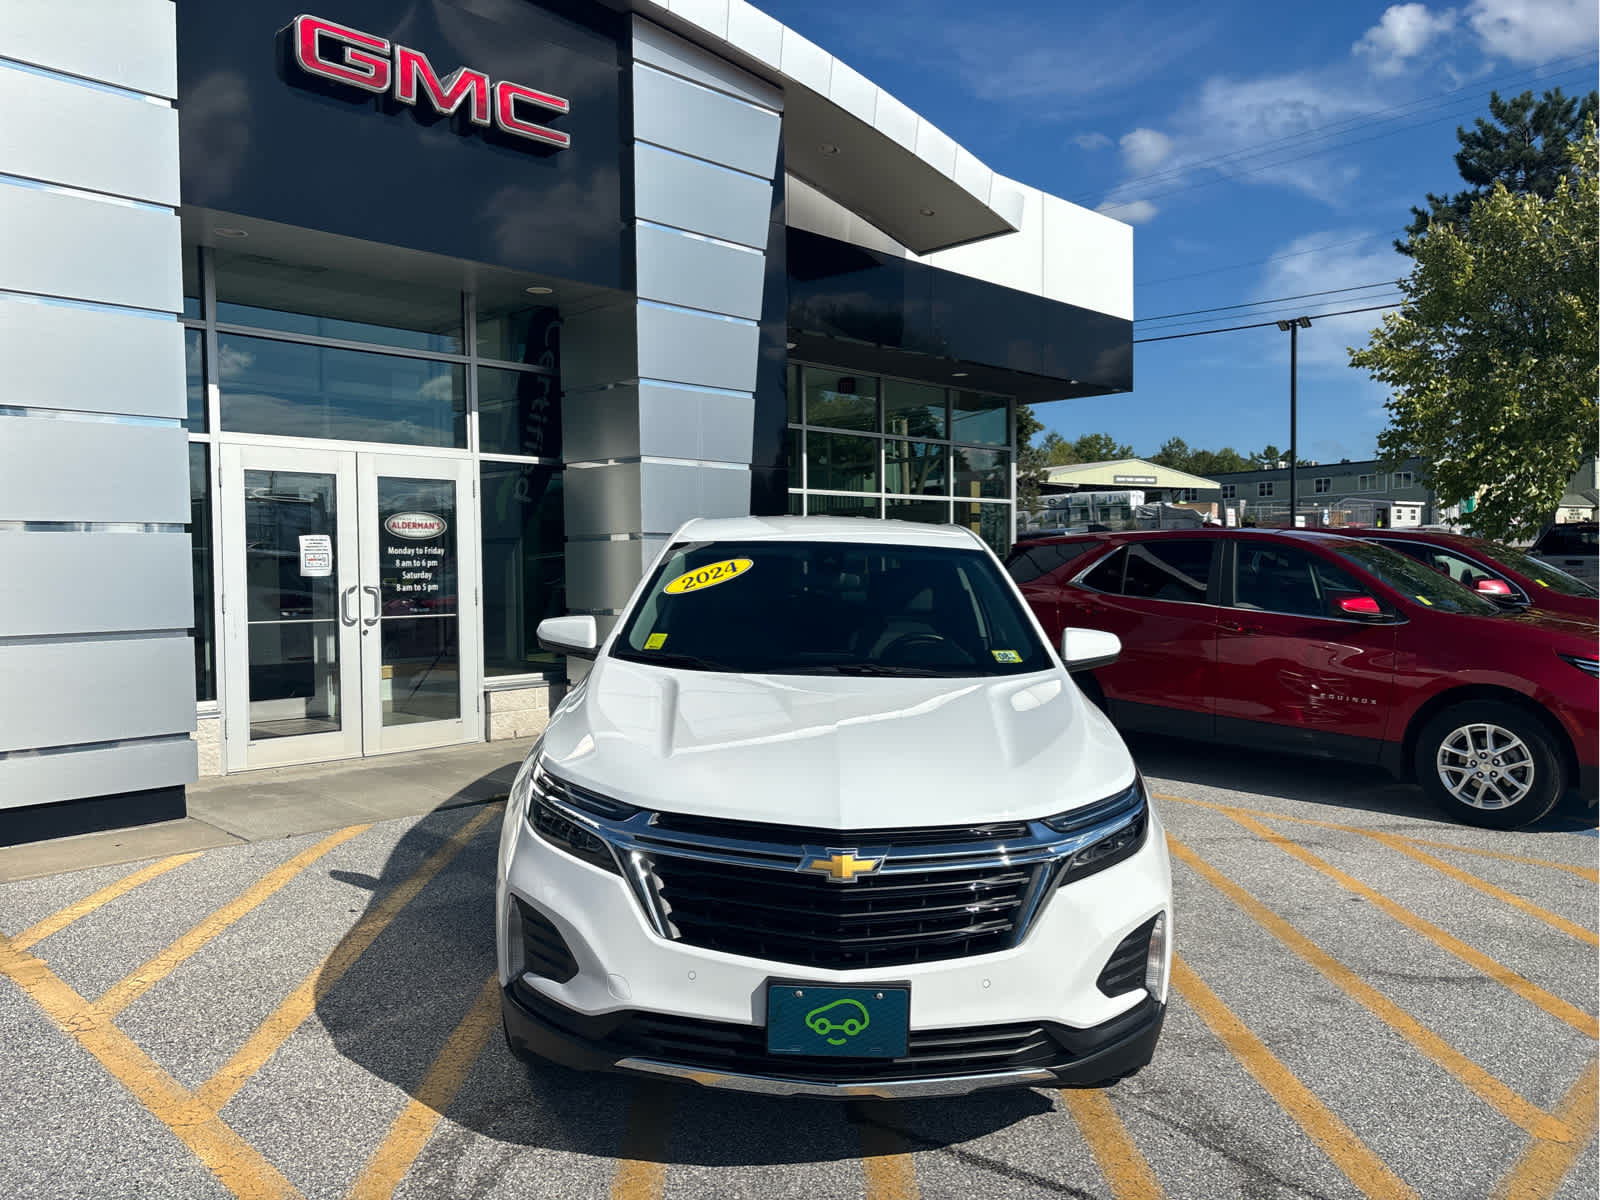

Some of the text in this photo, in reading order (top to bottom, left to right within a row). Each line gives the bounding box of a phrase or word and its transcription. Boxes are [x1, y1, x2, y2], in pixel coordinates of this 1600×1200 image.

[294, 14, 570, 149] GMC
[391, 521, 441, 530] ALDERMAN'S
[388, 546, 445, 557] Monday to Friday
[395, 559, 401, 568] 8
[413, 559, 421, 567] to
[421, 559, 426, 567] 6
[427, 560, 438, 568] pm
[402, 571, 433, 581] Saturday
[681, 561, 738, 591] 2024
[396, 583, 401, 592] 8
[413, 584, 421, 592] to
[422, 583, 427, 591] 5
[427, 584, 439, 592] pm
[1320, 692, 1377, 705] EQUINOX
